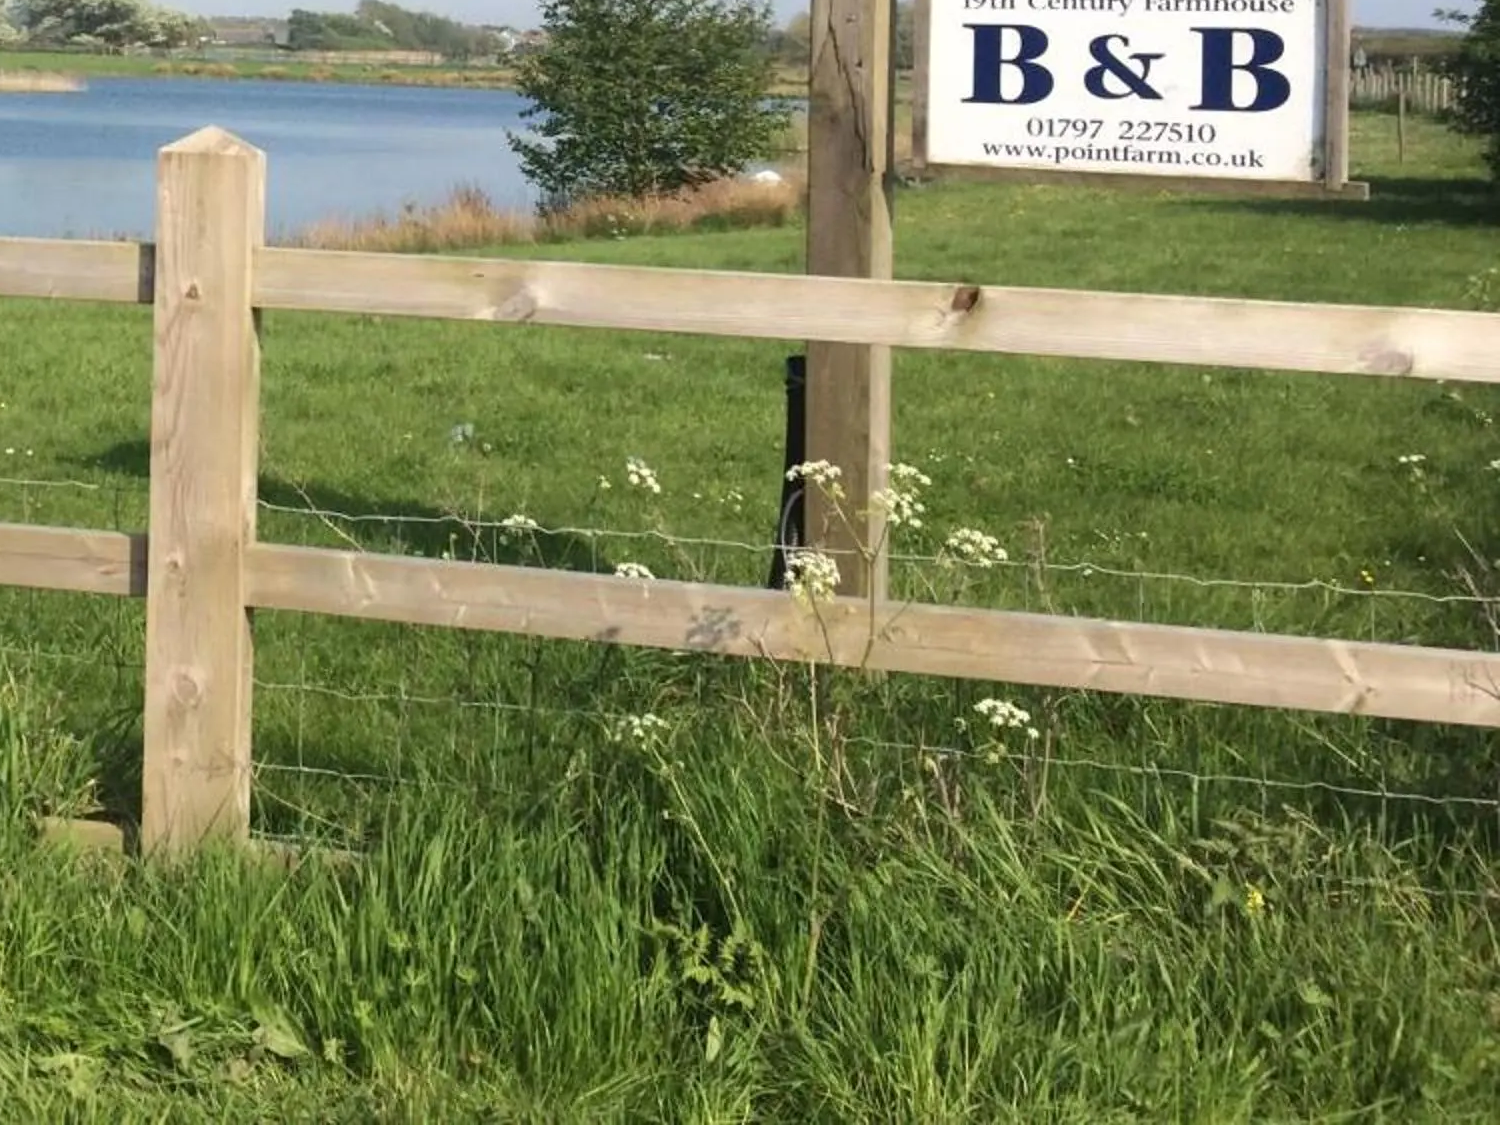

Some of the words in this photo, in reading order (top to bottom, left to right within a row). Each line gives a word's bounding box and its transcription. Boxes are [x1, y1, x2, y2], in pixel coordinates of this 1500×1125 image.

[960, 22, 1055, 106] B
[1083, 33, 1166, 101] &
[1187, 26, 1291, 113] B
[1026, 118, 1104, 139] 01797
[1118, 120, 1217, 144] 227510
[982, 141, 1264, 169] www.pointfarm.co.uk
